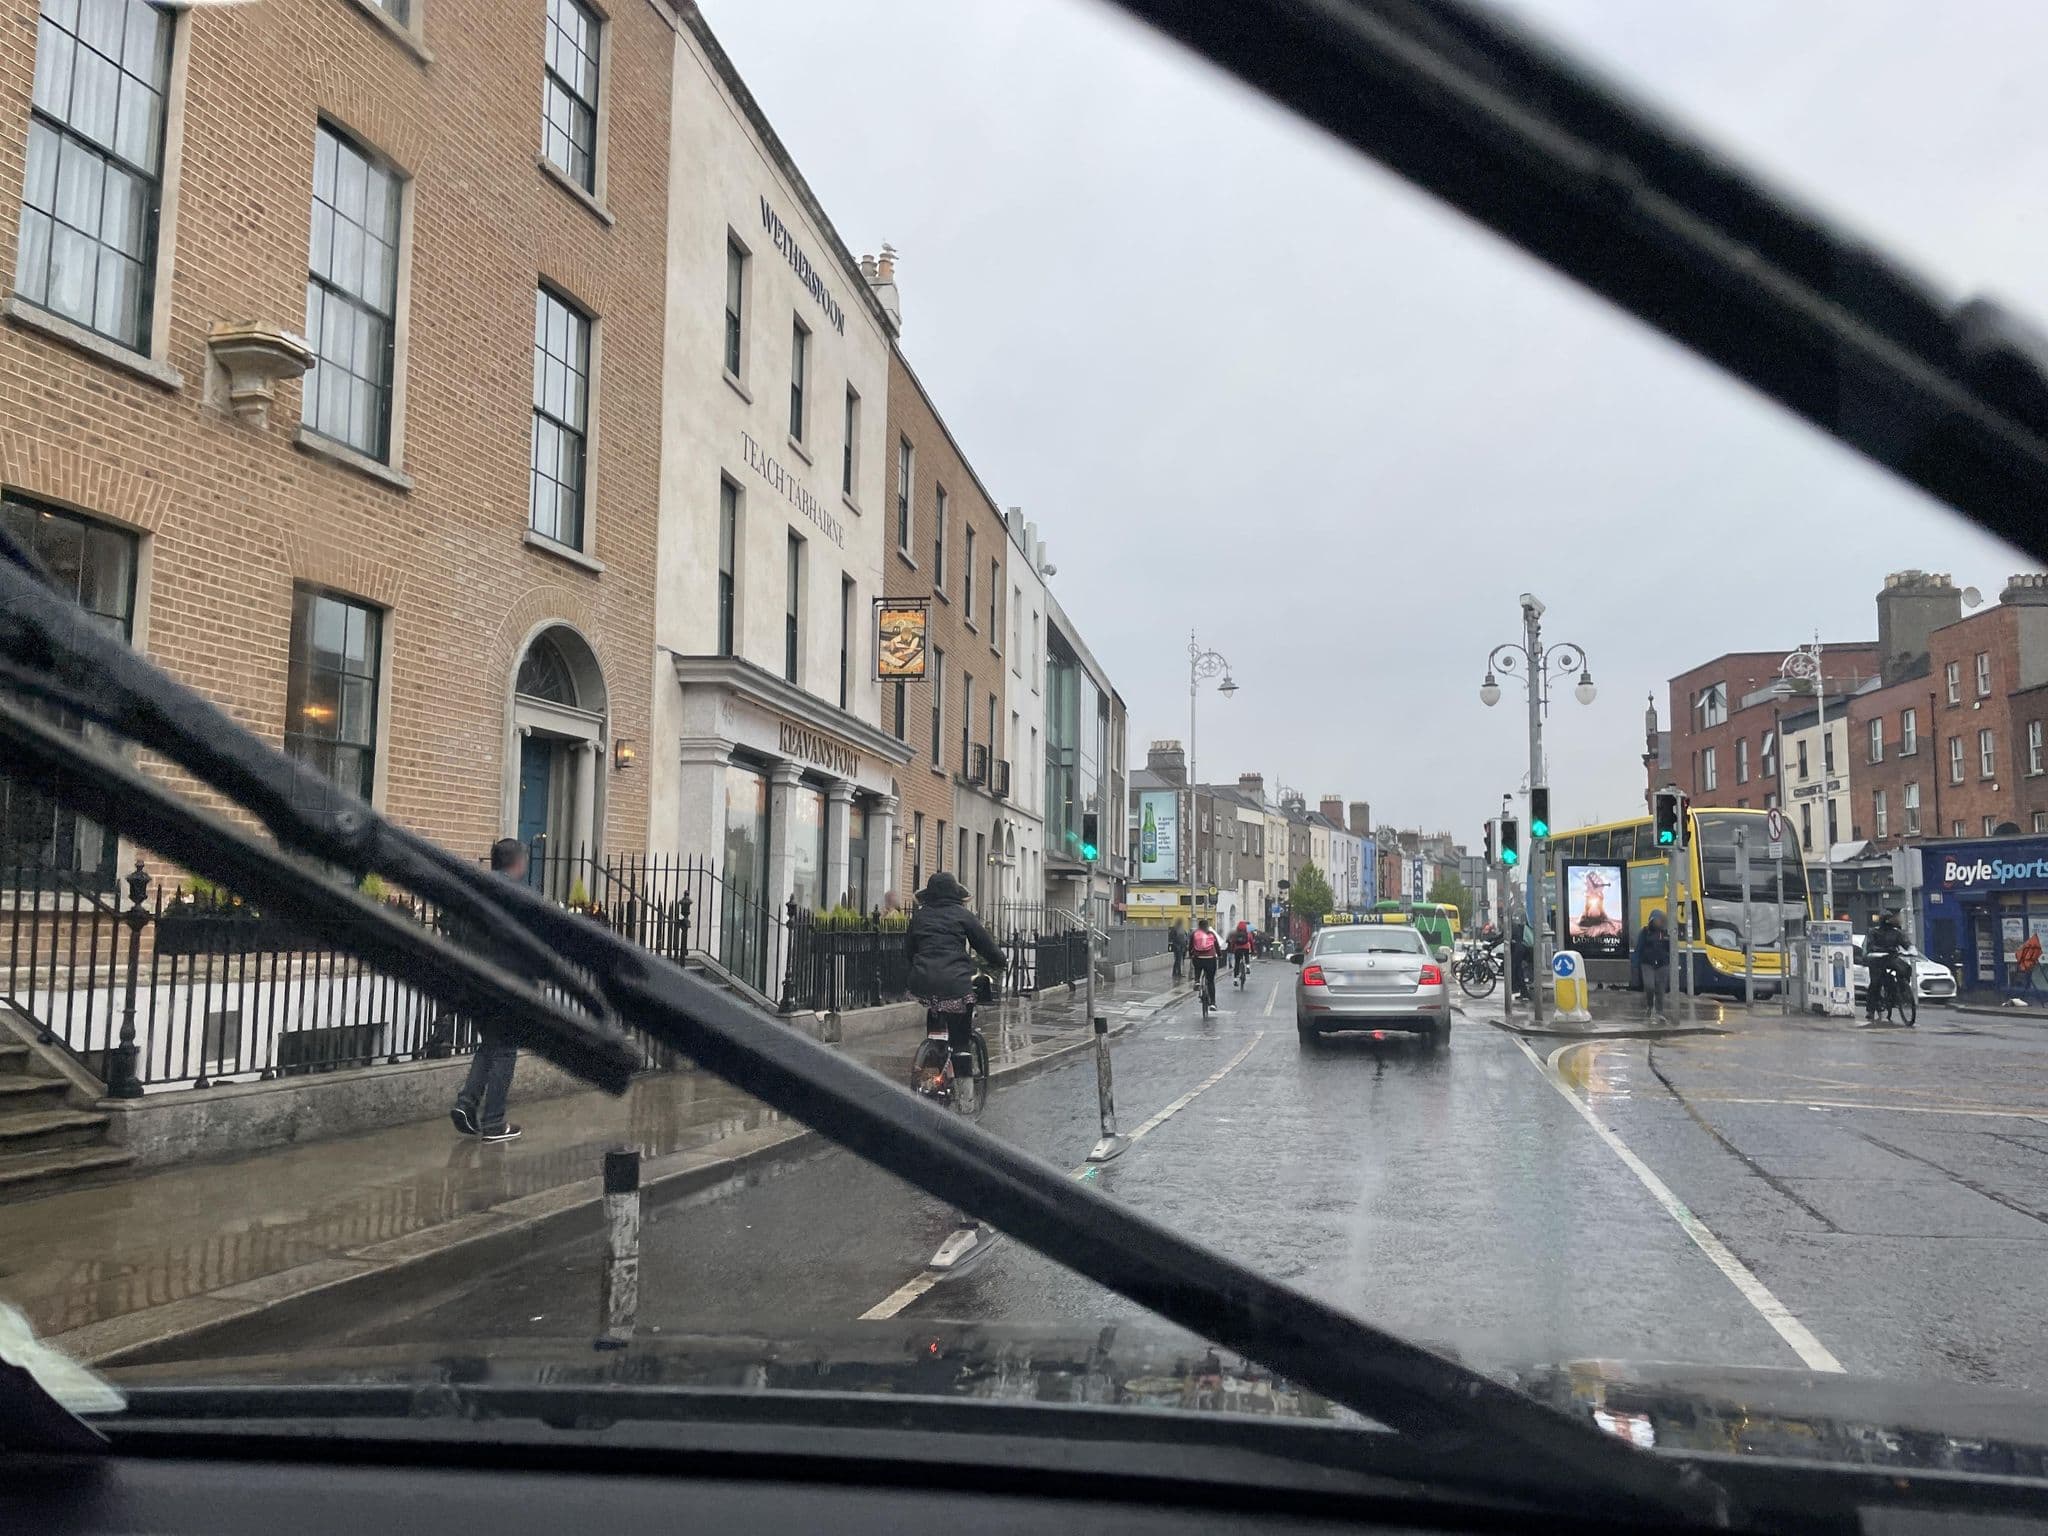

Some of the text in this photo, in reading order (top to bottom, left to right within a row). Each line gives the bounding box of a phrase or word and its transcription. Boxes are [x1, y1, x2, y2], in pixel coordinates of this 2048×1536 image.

[760, 194, 845, 337] WETHERSPOON
[741, 430, 785, 495] TEACH
[1944, 858, 2048, 886] BoyleSports
[1357, 913, 1380, 923] TAXI
